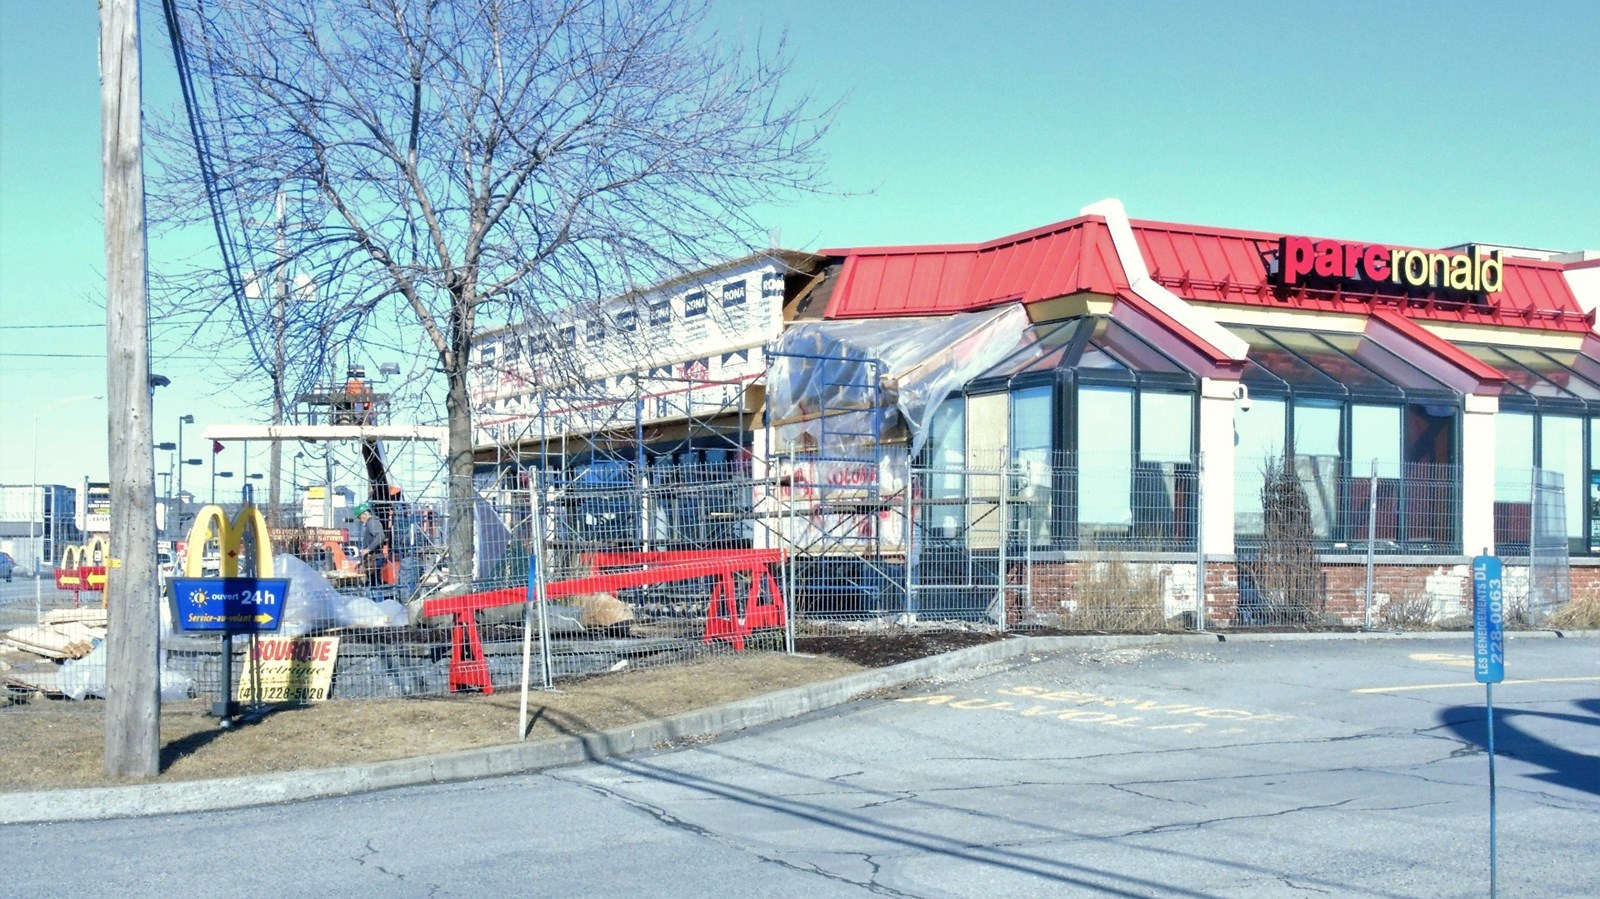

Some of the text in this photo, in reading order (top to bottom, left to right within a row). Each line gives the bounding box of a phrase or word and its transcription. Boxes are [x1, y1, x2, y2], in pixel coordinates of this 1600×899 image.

[723, 287, 745, 300] RONA
[211, 593, 239, 601] ouvert
[1474, 563, 1489, 675] LES DÉNEIGEMENTS DL
[1489, 579, 1503, 665] 228-0063
[252, 640, 332, 663] BOURQUE
[250, 662, 325, 678] lectrique
